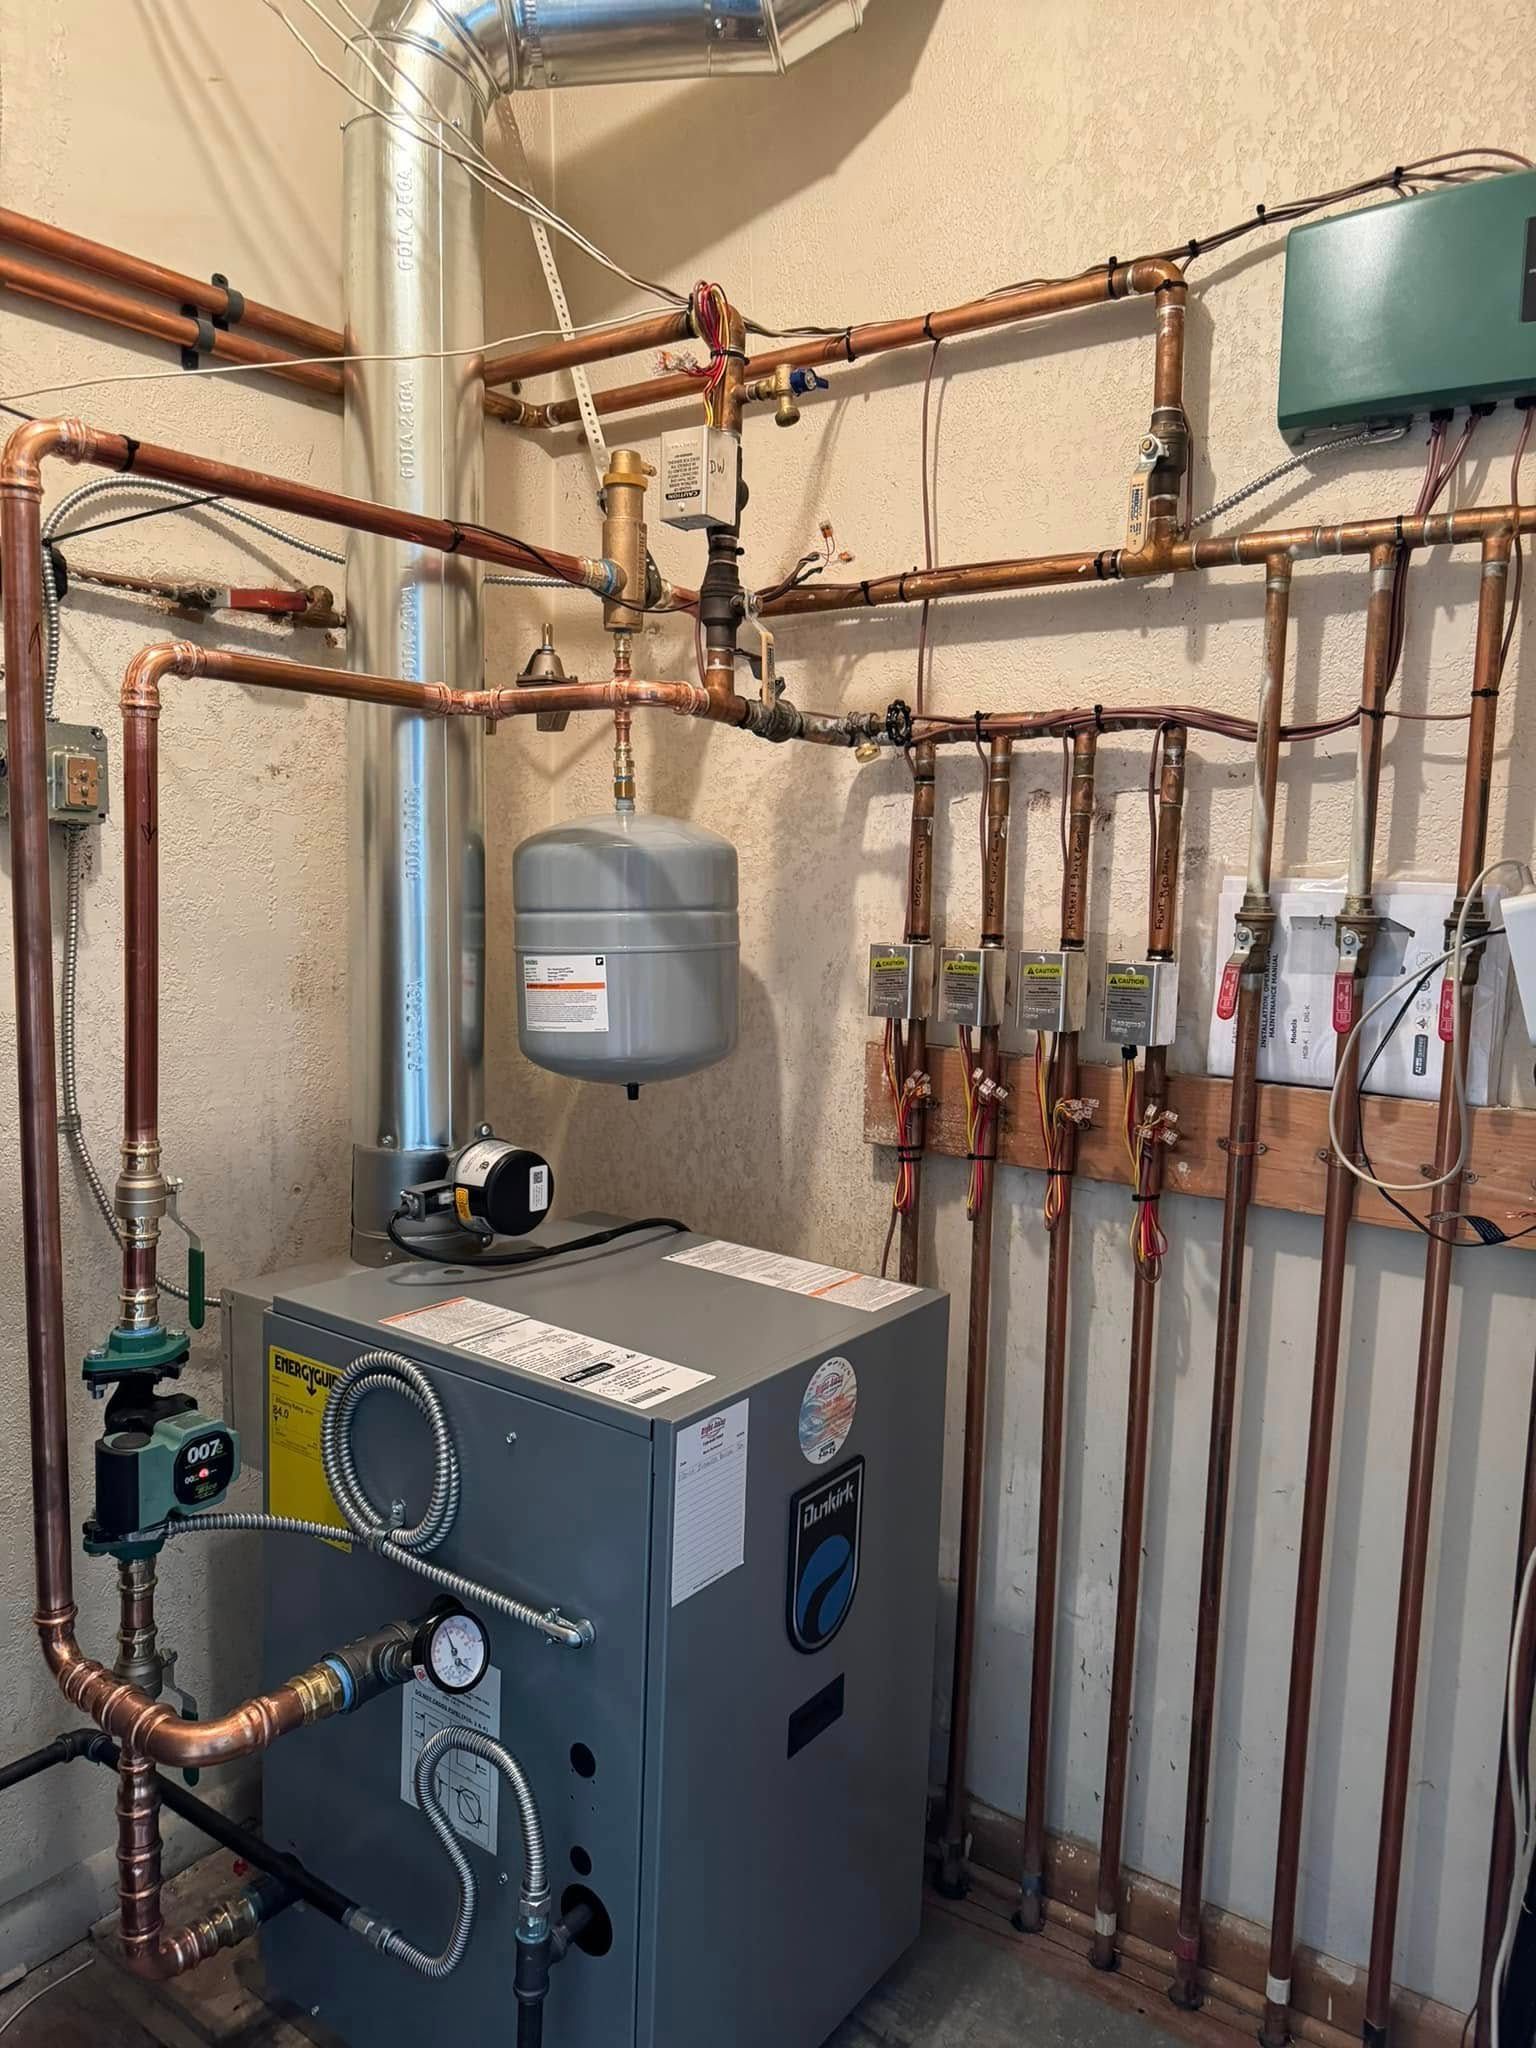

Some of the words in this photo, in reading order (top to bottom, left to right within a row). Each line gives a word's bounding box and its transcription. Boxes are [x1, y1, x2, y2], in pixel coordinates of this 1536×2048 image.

[710, 457, 725, 474] DW
[882, 959, 905, 967] CAUTION
[954, 963, 978, 972] CAUTION
[1034, 967, 1060, 975] CAUTION
[1117, 977, 1145, 986] CAUTION
[1268, 989, 1277, 1038] MAINTENANCE
[1290, 1019, 1298, 1044] Models
[275, 1354, 341, 1390] ENERGYGUID
[803, 1481, 854, 1529] Dunkirk
